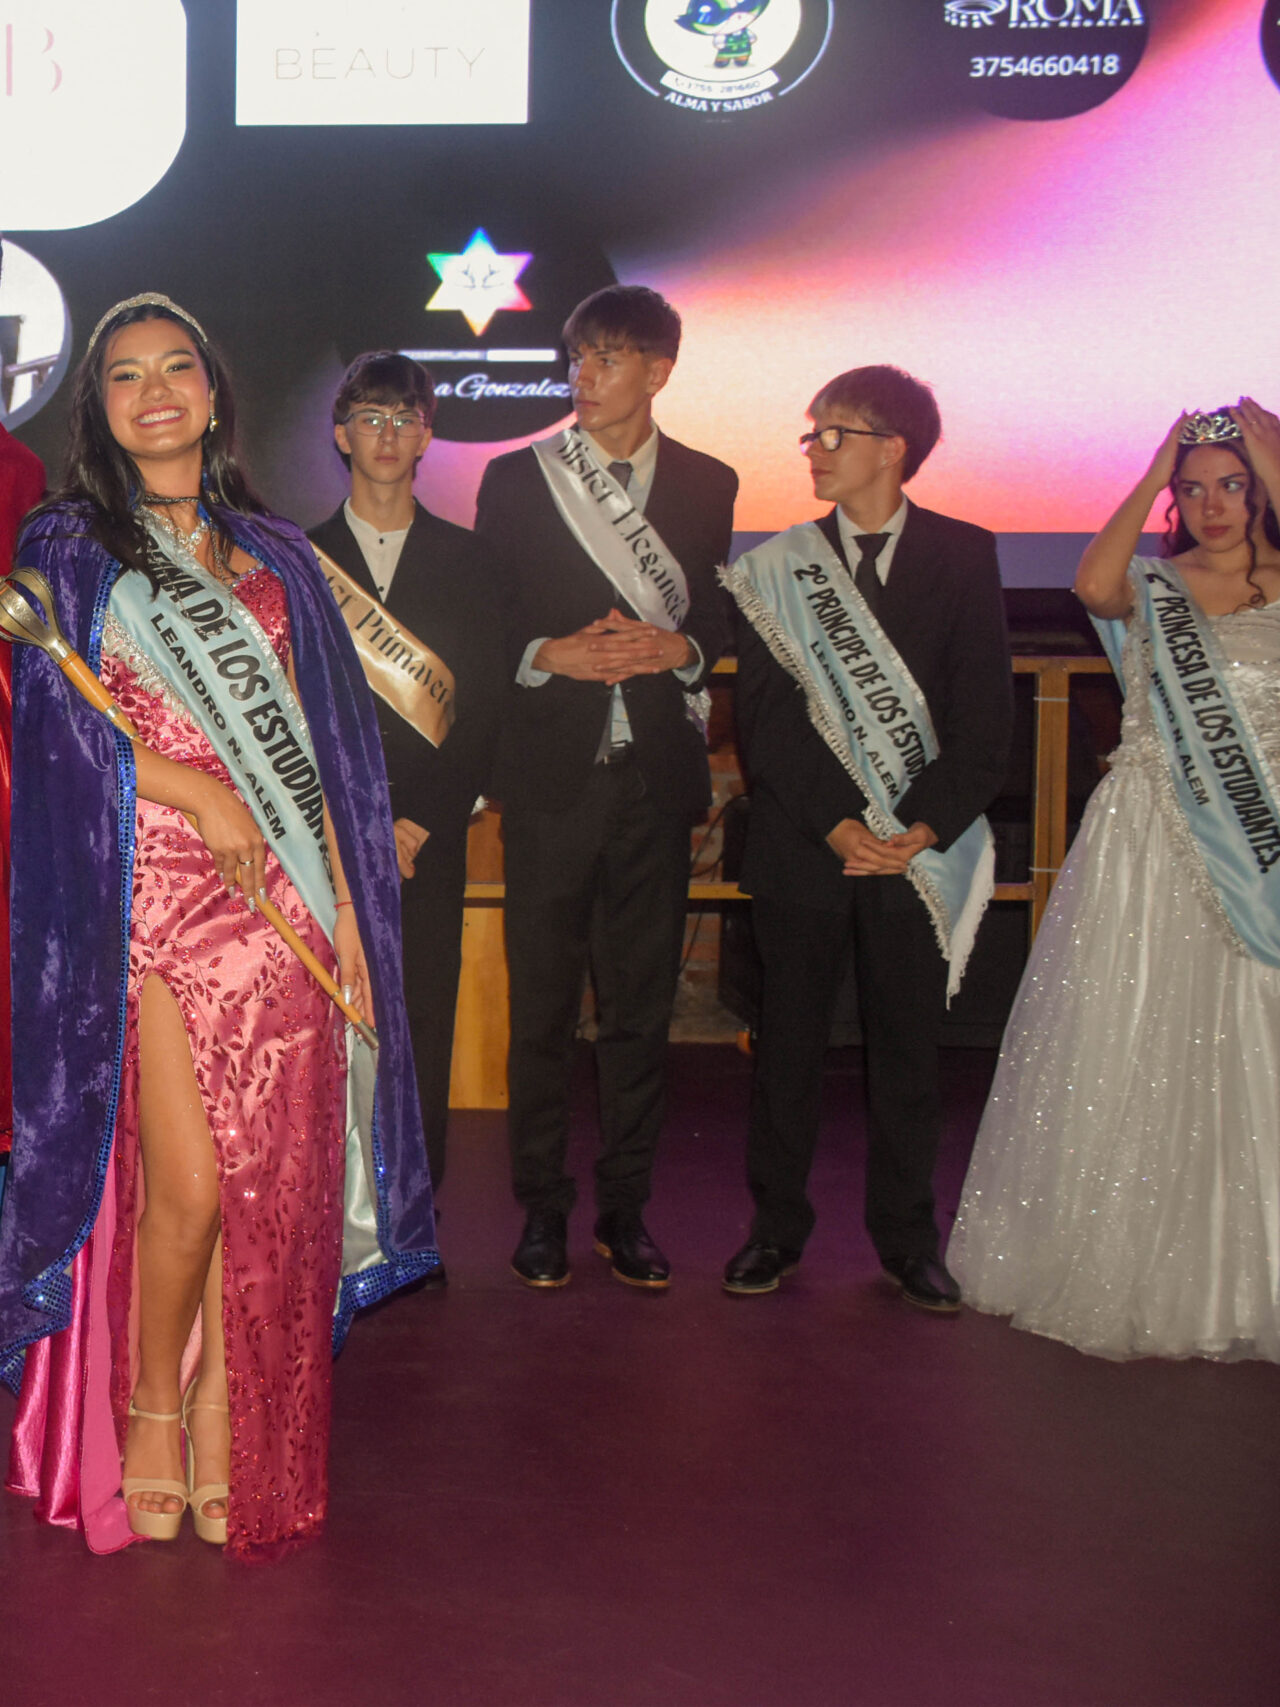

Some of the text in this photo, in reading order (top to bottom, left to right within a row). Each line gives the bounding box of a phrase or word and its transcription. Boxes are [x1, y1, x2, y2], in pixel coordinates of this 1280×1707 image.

[275, 47, 485, 79] BEAUTY
[969, 54, 1119, 77] 3754660418
[664, 91, 774, 112] ALMA Y SABOR
[455, 373, 570, 401] Gonzalez
[180, 598, 239, 643] DE
[806, 587, 872, 665] PRINCIPE
[1152, 596, 1210, 679] PRINCESA
[208, 638, 270, 702] LOS
[848, 661, 887, 691] DE
[865, 687, 908, 724] LOS
[1181, 677, 1222, 704] DE
[150, 612, 286, 841] LEANDRO N. ALEM
[810, 640, 900, 800] LEANDRO N. ALEM
[1192, 704, 1237, 742] LOS
[1179, 754, 1210, 806] ALEM
